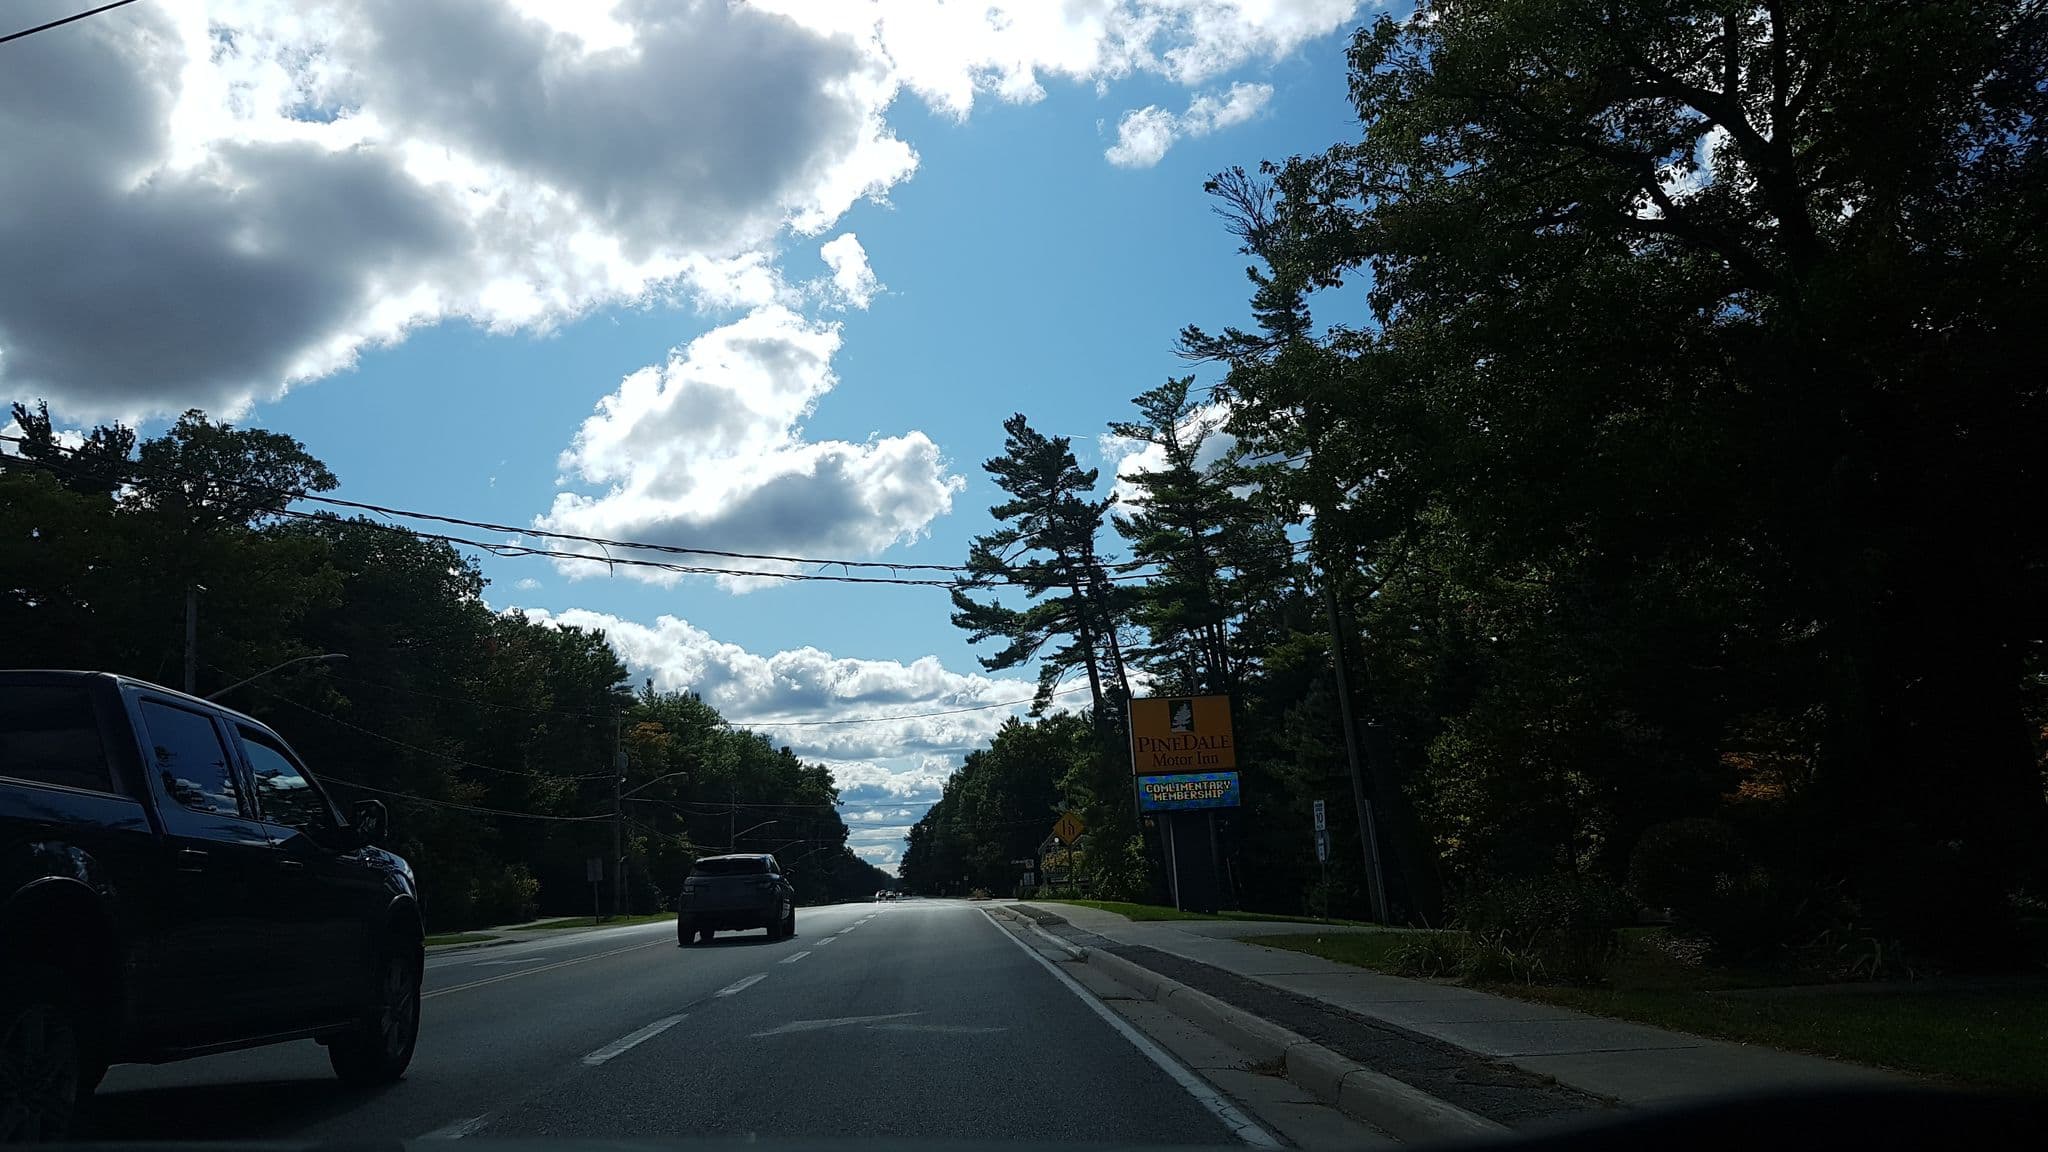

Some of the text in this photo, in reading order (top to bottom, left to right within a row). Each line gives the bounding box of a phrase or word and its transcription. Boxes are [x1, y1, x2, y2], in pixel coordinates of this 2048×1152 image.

[1153, 751, 1219, 767] Motor Inn
[1146, 780, 1231, 793] COMLIMENTARY
[1154, 789, 1224, 801] MEMBERSHIP
